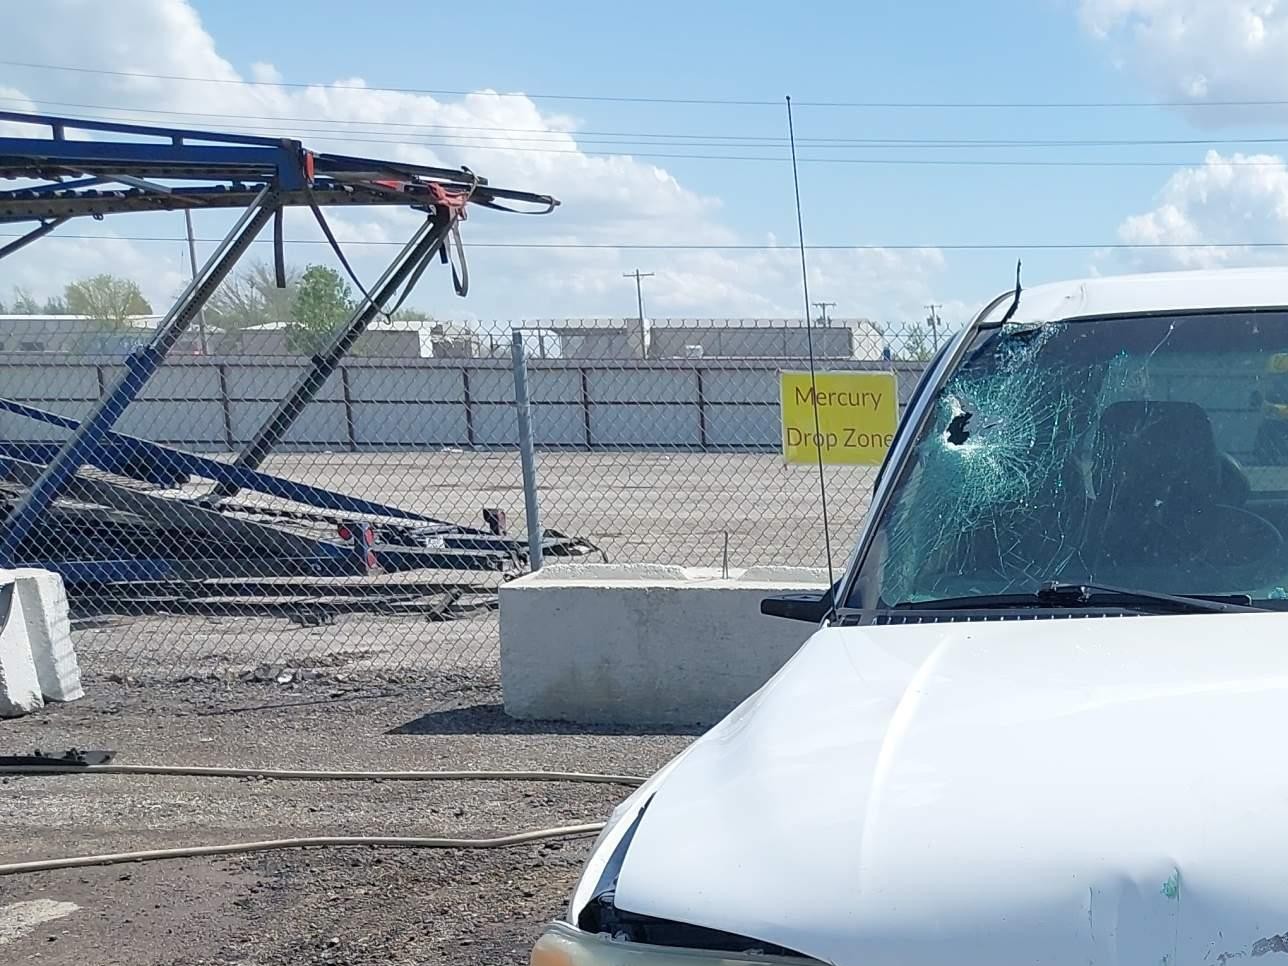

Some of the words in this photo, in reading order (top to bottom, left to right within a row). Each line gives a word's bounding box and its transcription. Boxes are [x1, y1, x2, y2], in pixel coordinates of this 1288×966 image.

[795, 386, 882, 411] Mercury
[786, 427, 838, 452] Drop
[842, 428, 894, 448] Zone
